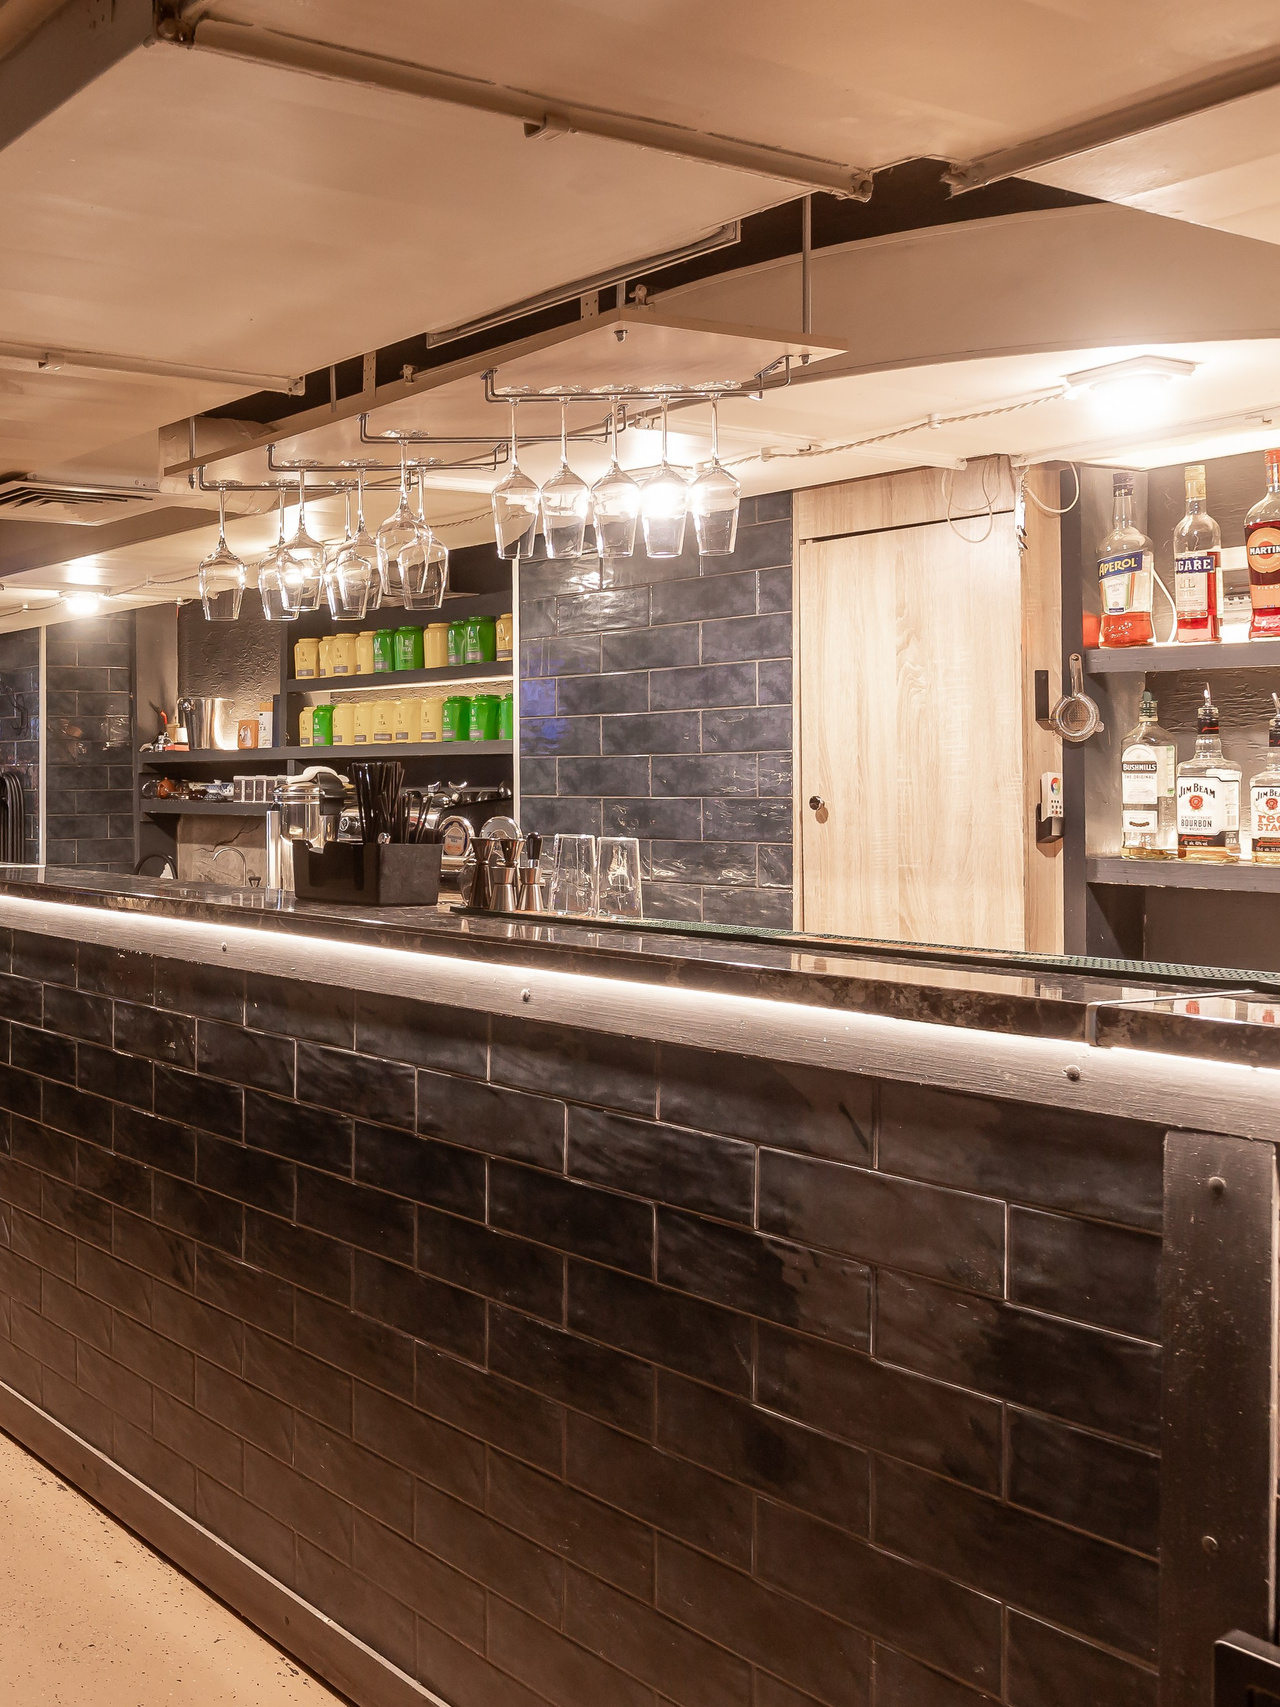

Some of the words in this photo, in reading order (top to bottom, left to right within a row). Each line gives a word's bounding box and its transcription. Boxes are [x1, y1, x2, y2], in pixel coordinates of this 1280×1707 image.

[1099, 557, 1138, 577] APEROL
[1122, 763, 1157, 771] BUSHMILLS
[1178, 786, 1192, 798] JIM
[1193, 783, 1216, 799] BEAM
[1255, 791, 1268, 801] JIM
[1181, 819, 1212, 827] BOURBON
